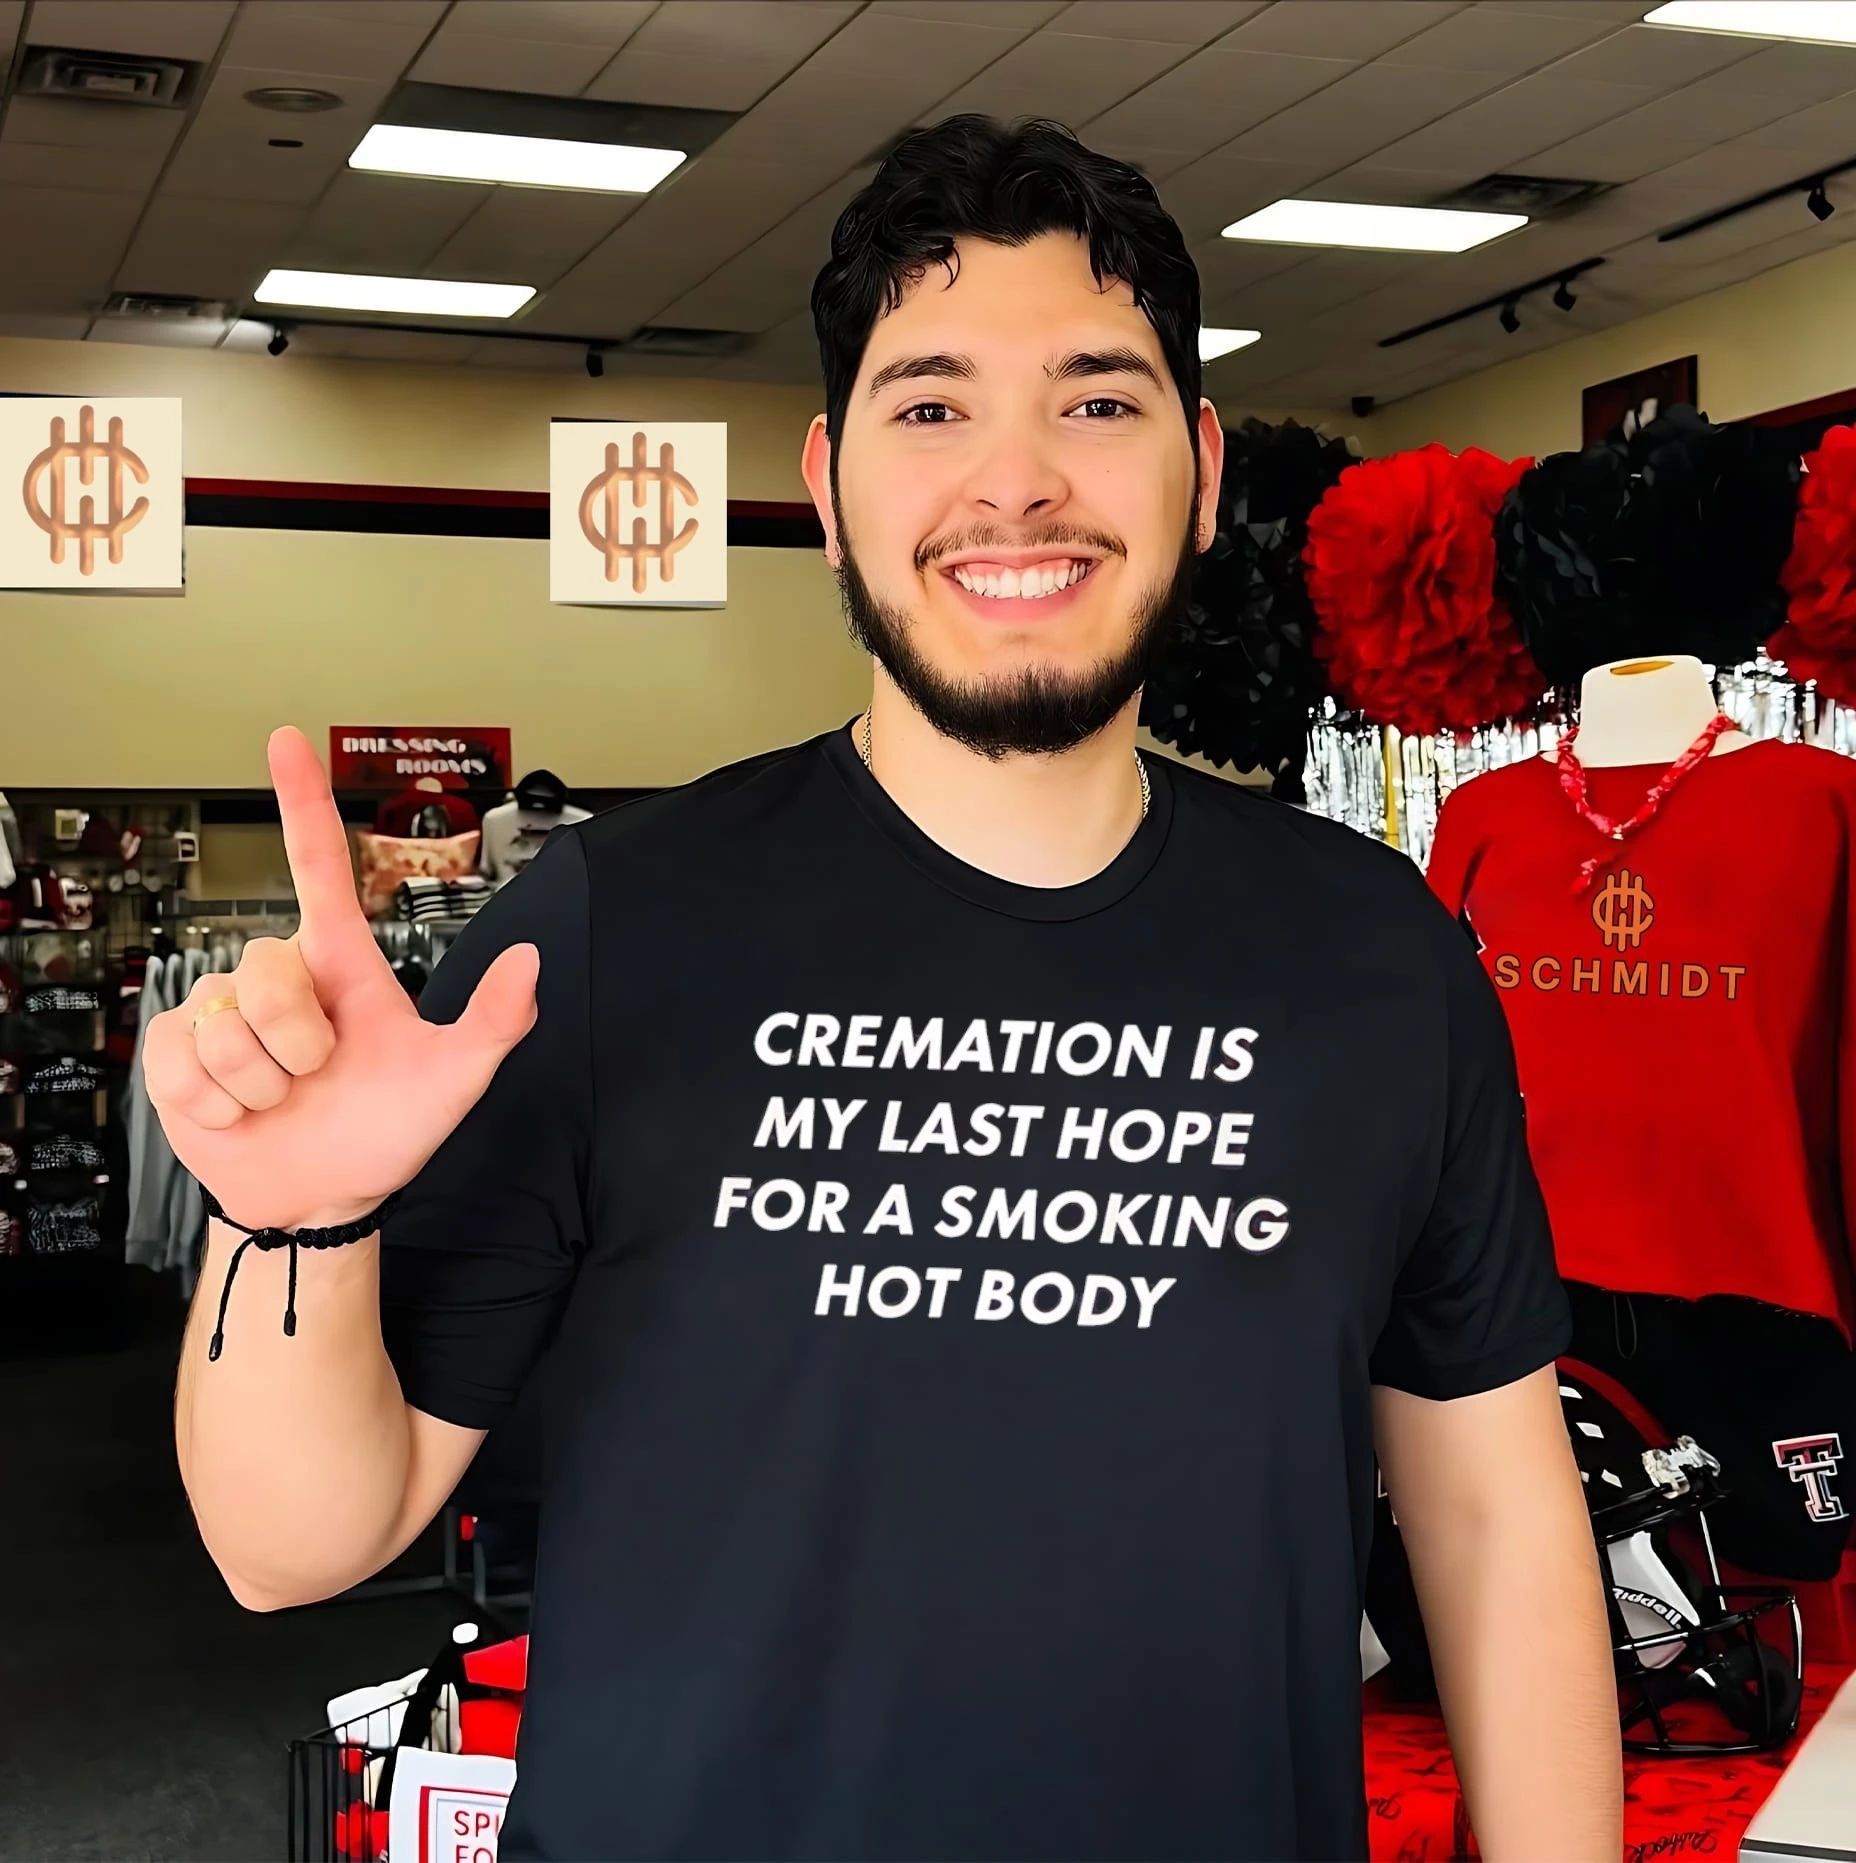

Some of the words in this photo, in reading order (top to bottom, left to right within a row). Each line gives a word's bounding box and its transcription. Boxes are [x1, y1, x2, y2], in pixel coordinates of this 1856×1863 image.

[396, 758, 487, 775] ROOMS
[1494, 954, 1747, 1000] SCHMIDT
[753, 1011, 1172, 1078] CREMATION
[1190, 1027, 1259, 1083] IS
[753, 1096, 868, 1151] MY
[878, 1100, 1046, 1156] LAST
[1056, 1107, 1255, 1166] HOPE
[713, 1176, 850, 1234] FOR
[863, 1183, 914, 1236] A
[933, 1185, 1290, 1252] SMOKING
[814, 1263, 963, 1319] HOT
[975, 1269, 1177, 1328] BODY
